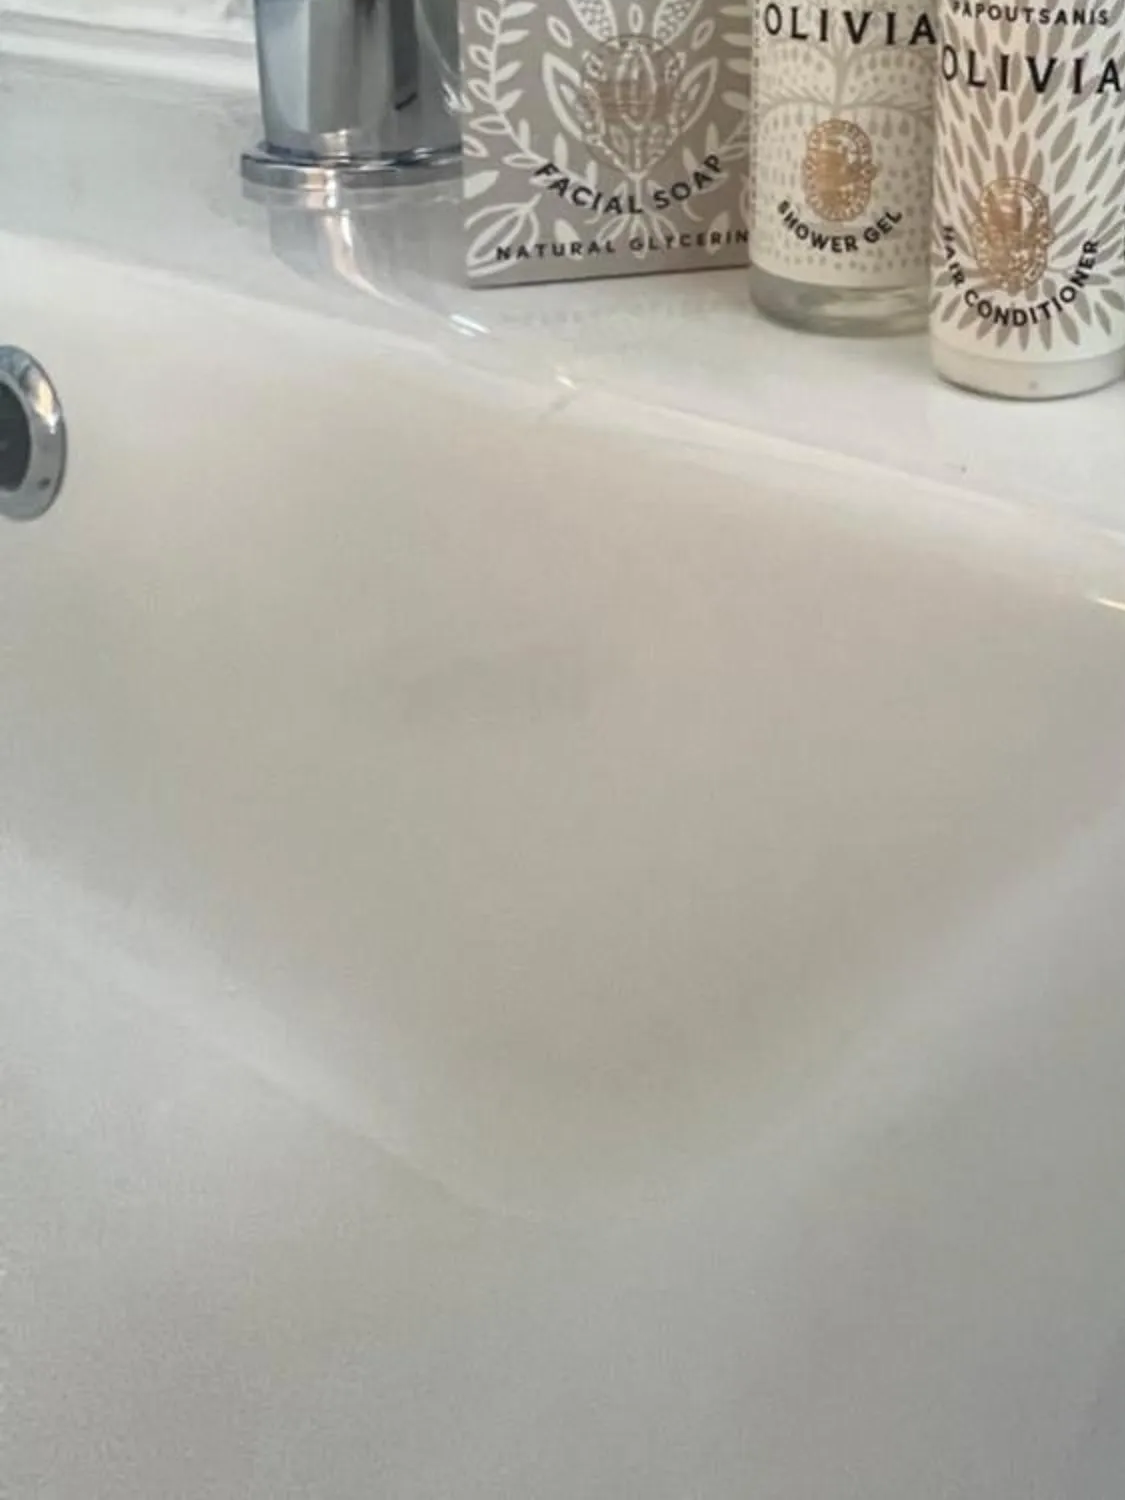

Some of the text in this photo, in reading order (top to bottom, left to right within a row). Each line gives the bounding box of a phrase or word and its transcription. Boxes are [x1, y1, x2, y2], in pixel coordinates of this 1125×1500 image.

[764, 2, 937, 46] OLIVIA
[951, 0, 1110, 26] PAPOUTSANIS
[941, 44, 1121, 94] OLIVIA
[534, 153, 723, 215] FACIAL SOAP
[495, 239, 616, 261] NATURAL
[777, 200, 903, 253] SHOWER GEL
[942, 225, 1101, 328] HAIR CONDITIONER
